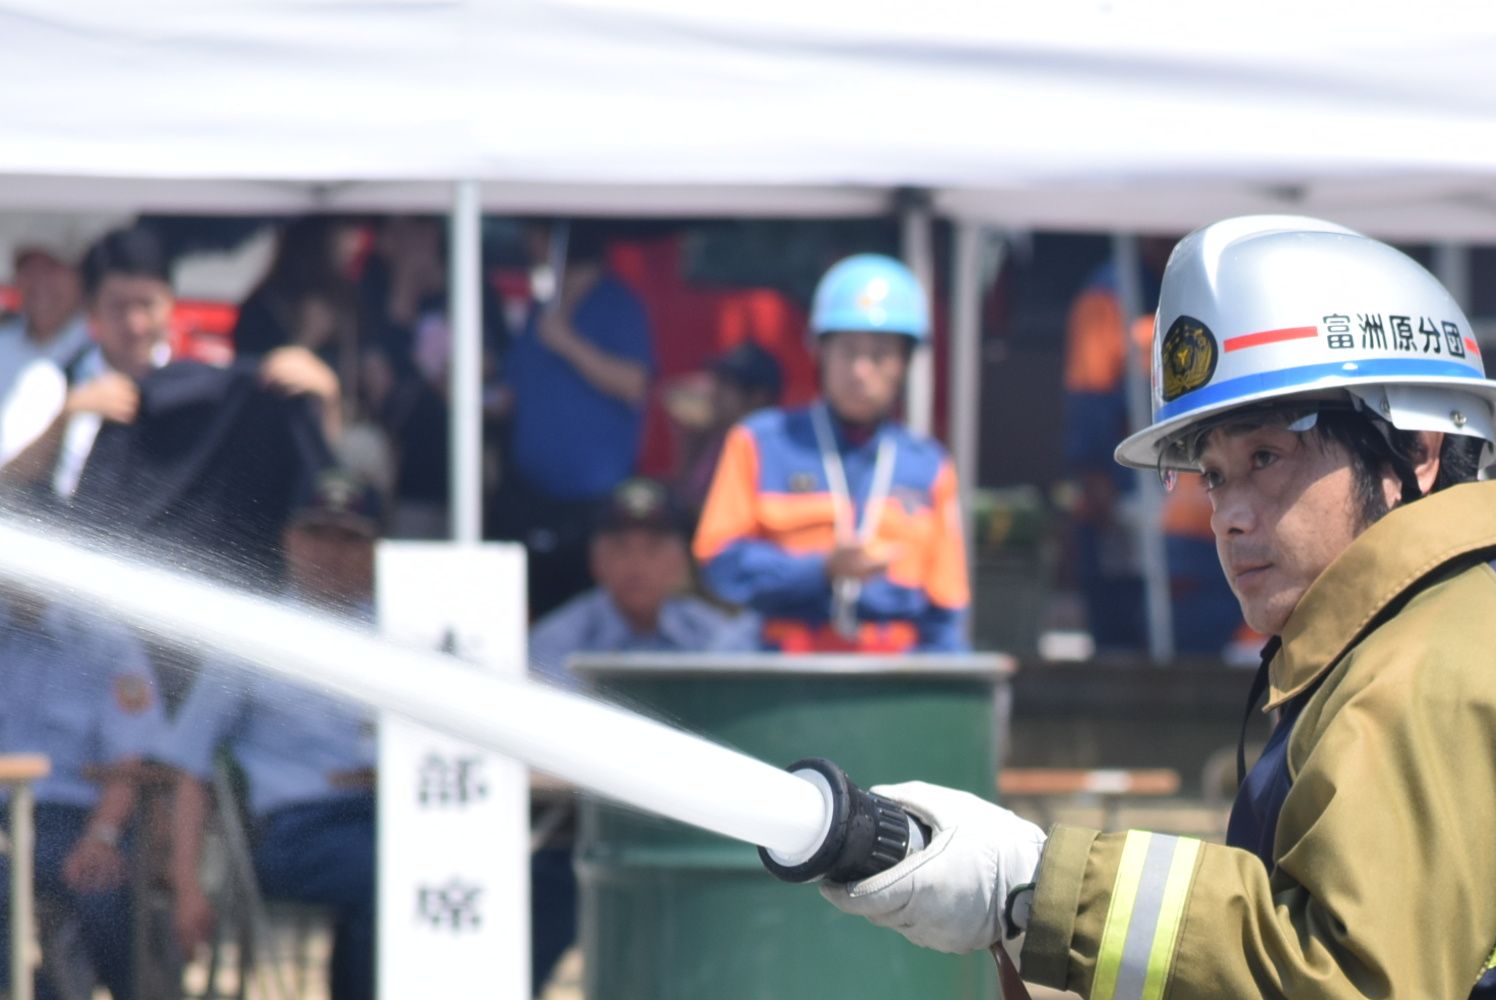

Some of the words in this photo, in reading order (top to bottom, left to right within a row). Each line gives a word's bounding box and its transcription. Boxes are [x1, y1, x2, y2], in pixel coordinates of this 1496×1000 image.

[1323, 313, 1466, 358] 富洲原分団
[416, 624, 488, 934] 部席
